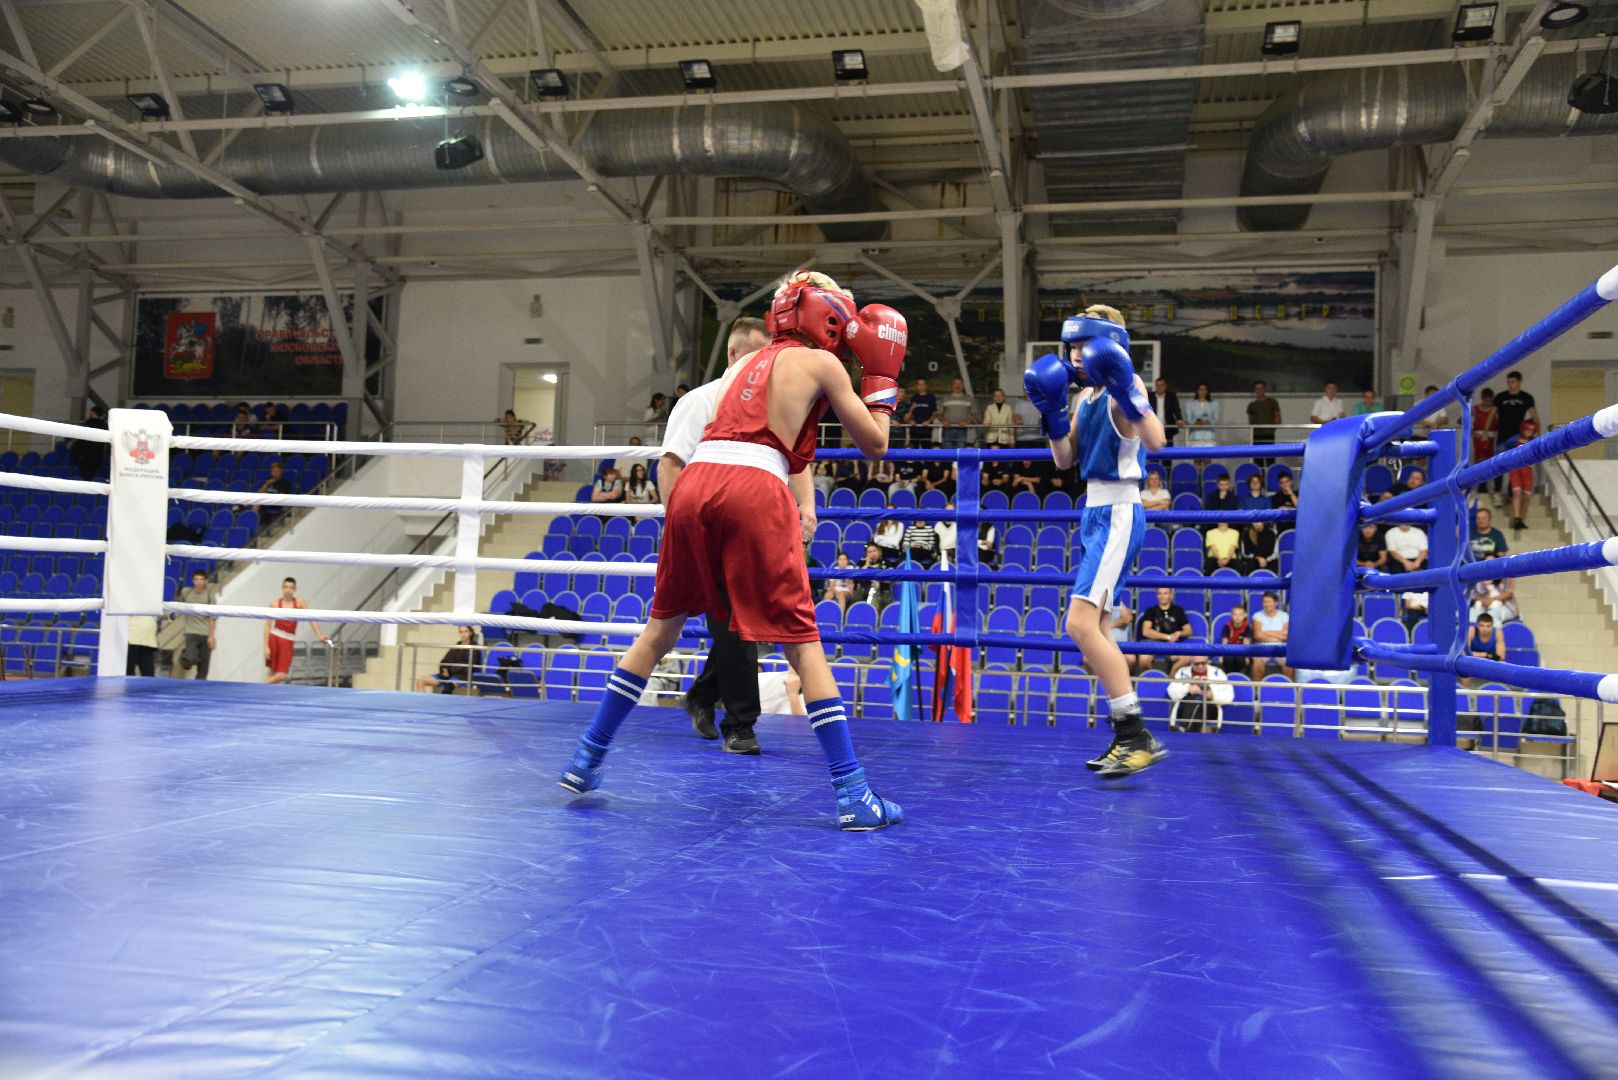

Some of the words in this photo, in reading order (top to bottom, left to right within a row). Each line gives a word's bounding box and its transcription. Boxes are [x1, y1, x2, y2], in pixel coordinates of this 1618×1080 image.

[256, 328, 335, 338] ПРАВИТЕЛЬСТ
[271, 342, 338, 352] МОСКОВСК
[295, 354, 343, 365] ОБЛАСТ
[739, 359, 769, 401] RUS
